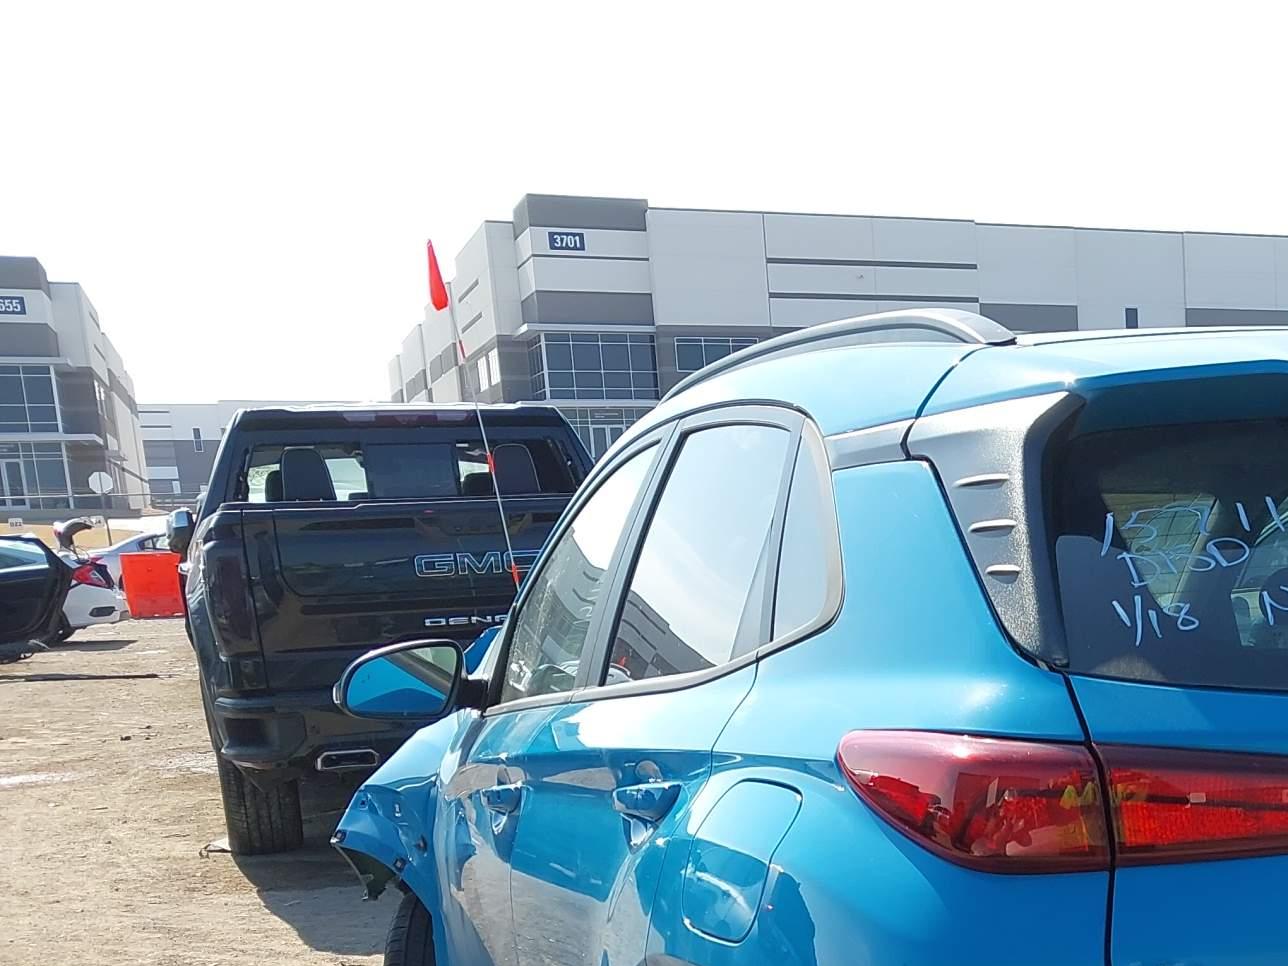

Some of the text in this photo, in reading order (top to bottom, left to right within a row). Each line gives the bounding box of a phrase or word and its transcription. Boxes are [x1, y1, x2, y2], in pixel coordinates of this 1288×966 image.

[553, 234, 581, 249] 3701
[414, 548, 542, 578] GMC
[1111, 594, 1200, 647] 1/18
